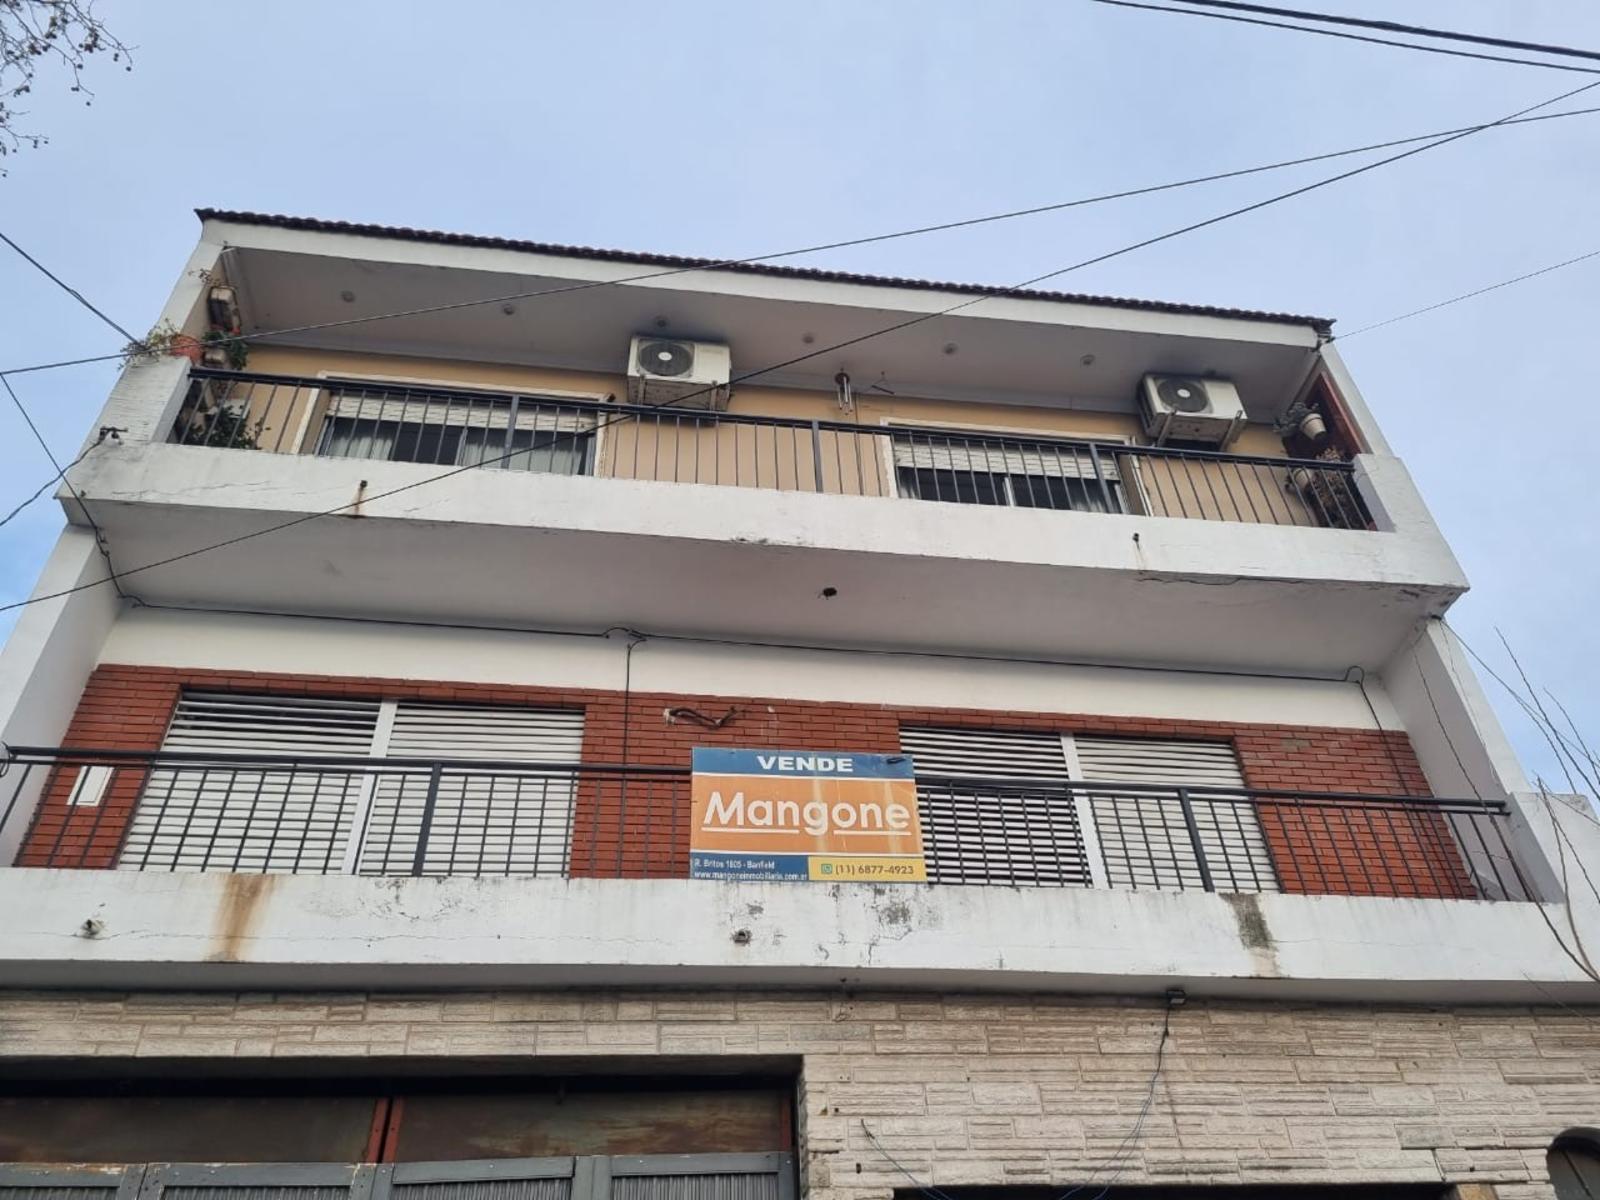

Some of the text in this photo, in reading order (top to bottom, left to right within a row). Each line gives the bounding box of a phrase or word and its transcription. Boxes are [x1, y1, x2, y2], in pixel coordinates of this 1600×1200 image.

[757, 756, 853, 772] VENDE
[702, 791, 911, 836] Mangone
[835, 864, 914, 875] (11) 6877-4923
